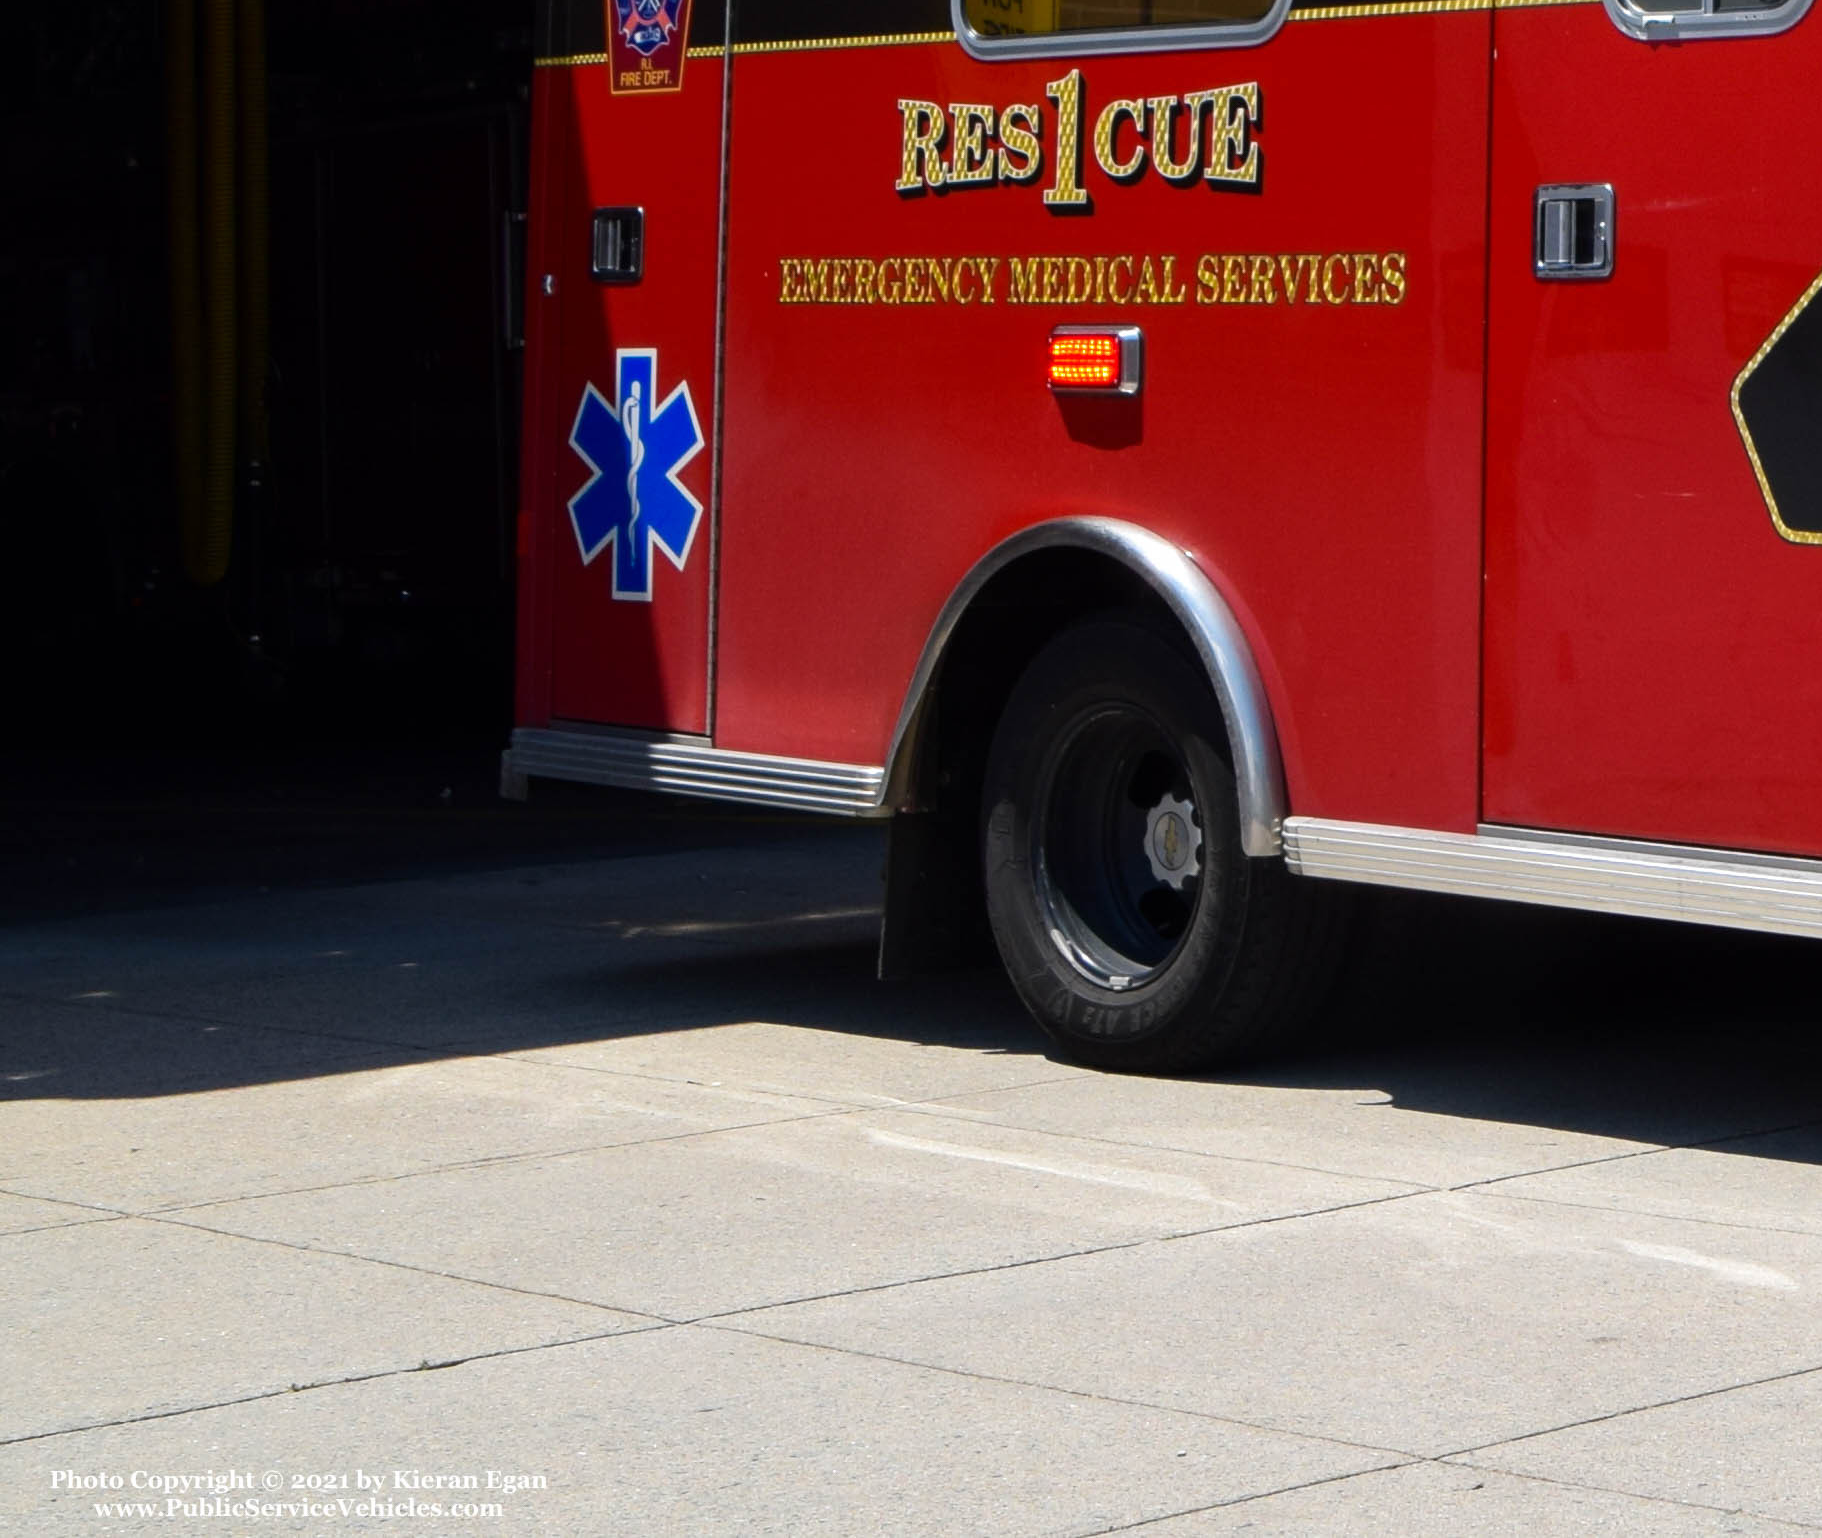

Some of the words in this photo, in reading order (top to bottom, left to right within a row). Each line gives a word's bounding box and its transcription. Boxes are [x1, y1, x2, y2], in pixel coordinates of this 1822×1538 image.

[620, 71, 642, 87] FIRE
[644, 70, 673, 85] DEPT.
[895, 69, 1258, 205] RES1CUE
[779, 258, 1000, 304] EMERGENCY
[1006, 256, 1186, 304] MEDICAL
[1196, 253, 1407, 305] SERVICES
